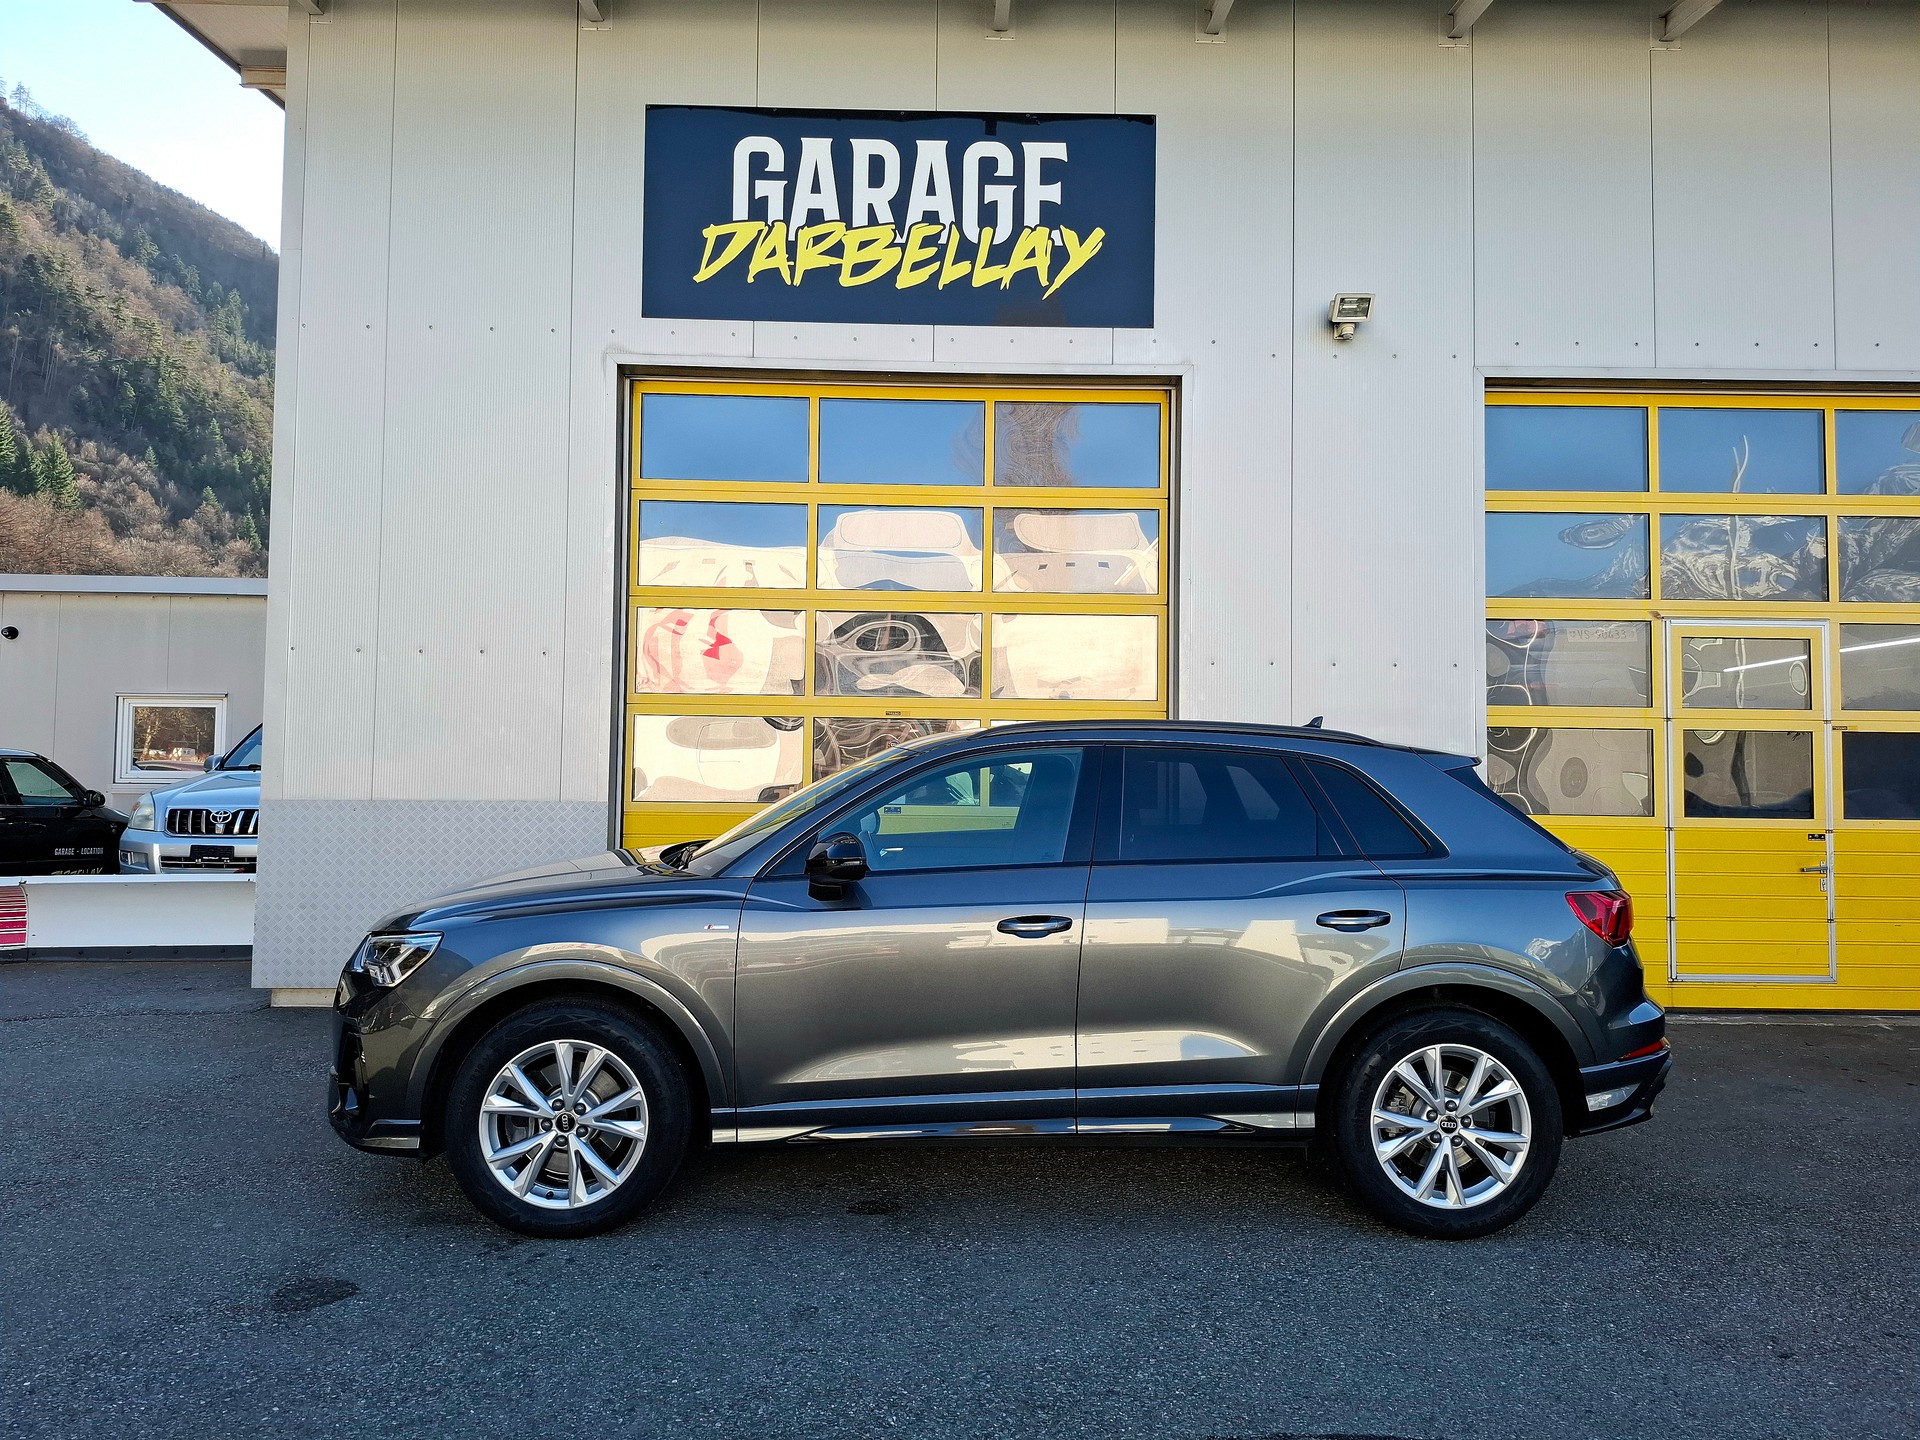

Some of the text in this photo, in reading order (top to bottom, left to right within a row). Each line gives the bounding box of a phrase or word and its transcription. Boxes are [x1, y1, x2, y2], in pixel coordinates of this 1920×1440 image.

[732, 135, 1069, 246] GARAGE
[692, 219, 1106, 300] DARBELLAY
[54, 847, 75, 856] GARAGE
[80, 847, 104, 855] LOCATION
